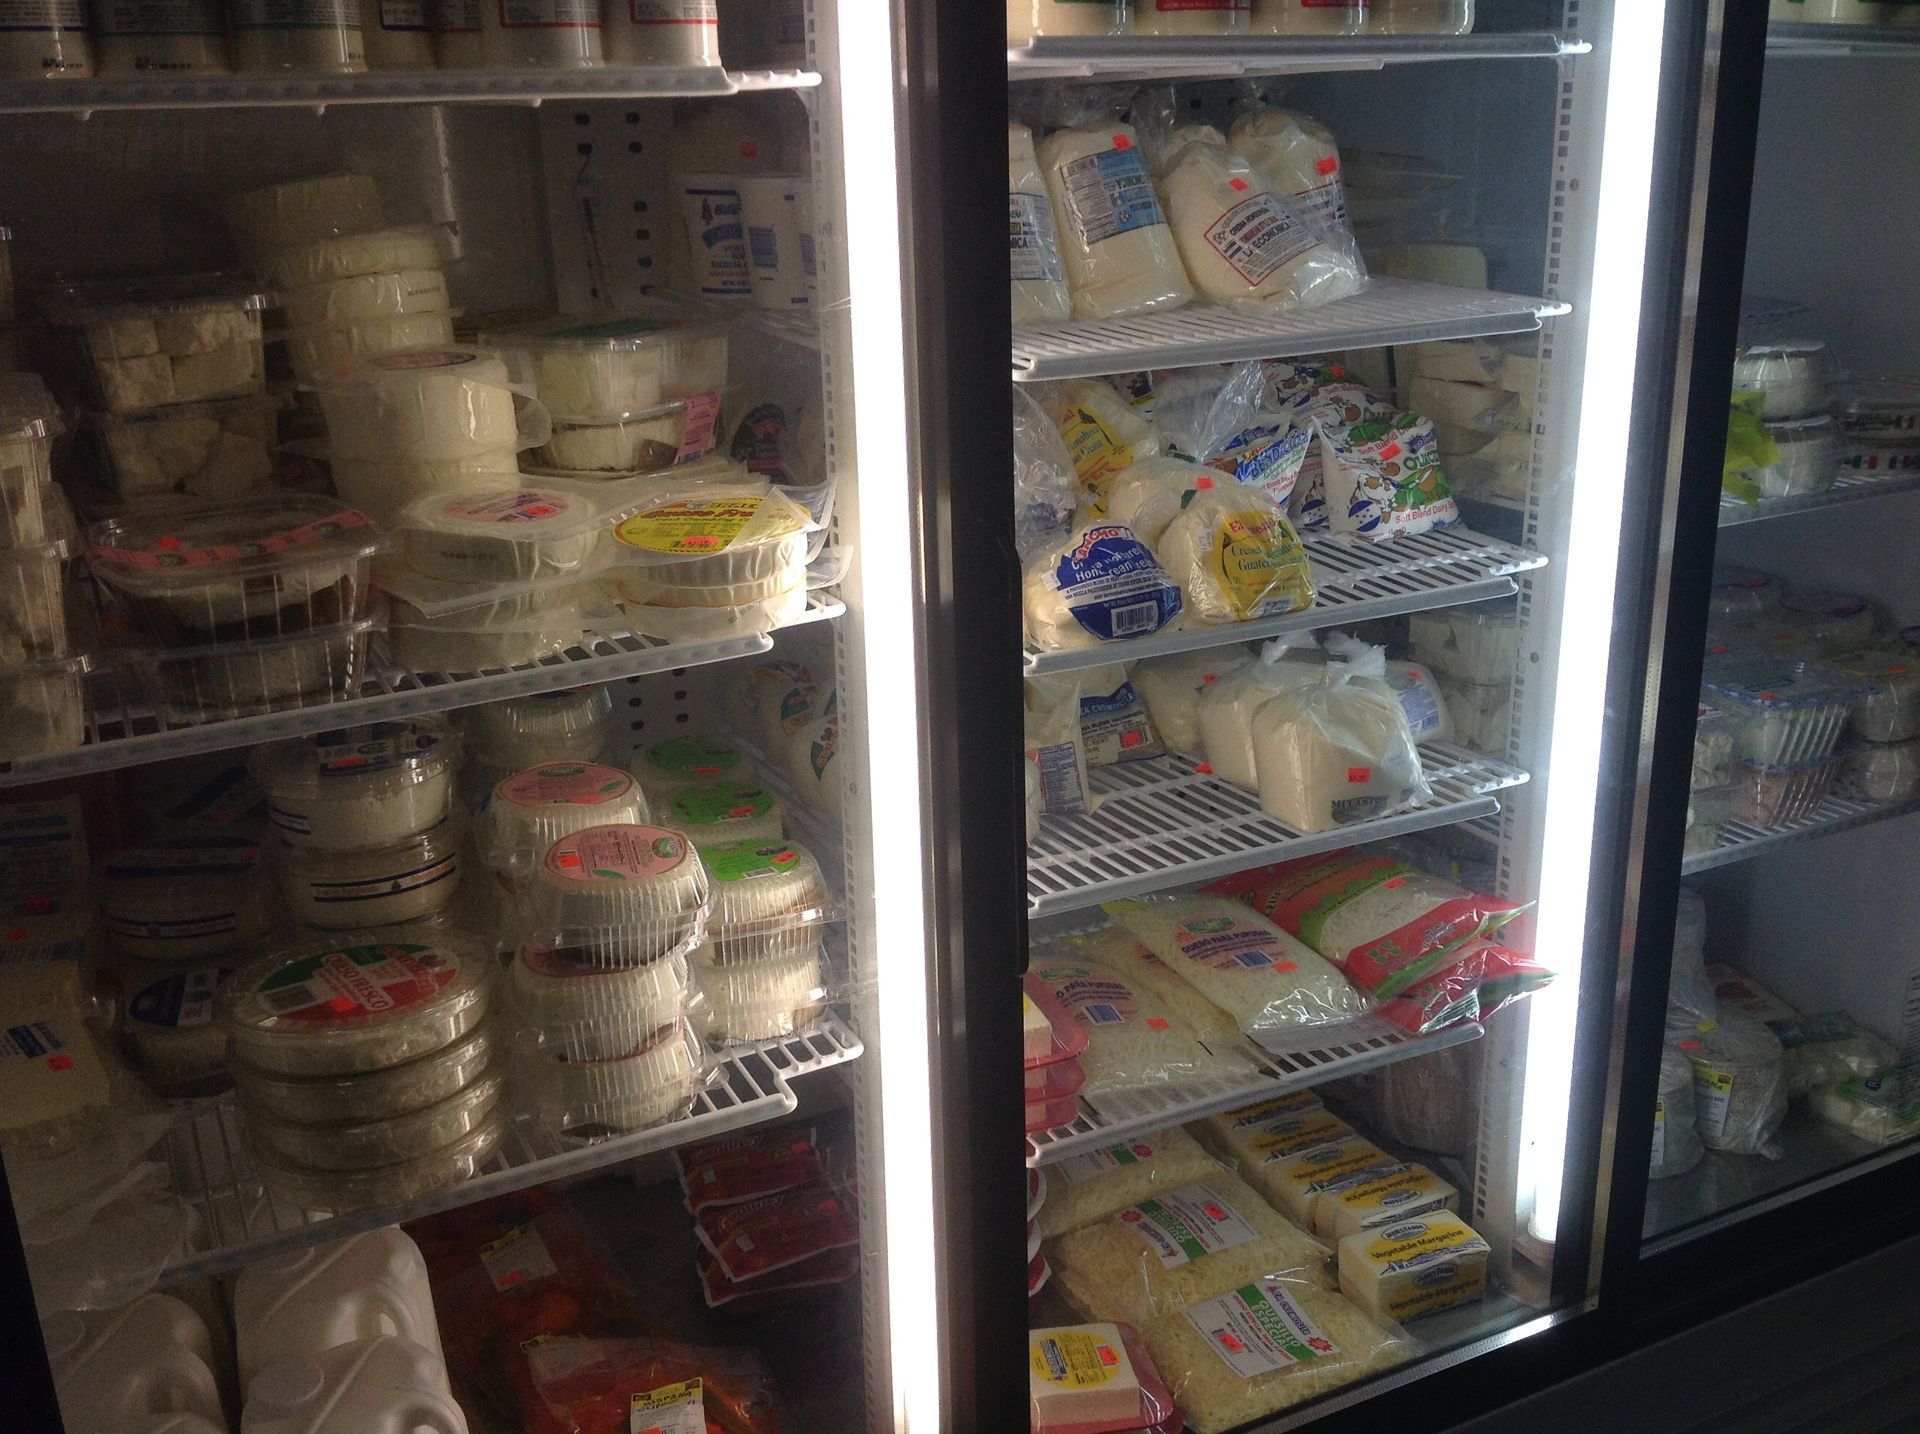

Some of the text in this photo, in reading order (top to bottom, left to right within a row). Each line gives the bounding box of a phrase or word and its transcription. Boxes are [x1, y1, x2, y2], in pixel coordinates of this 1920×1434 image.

[1375, 432, 1399, 450] Blend
[1395, 504, 1449, 524] Soft Blend Dairy
[1371, 1229, 1464, 1259] Vegetable Margarine
[1251, 1304, 1291, 1350] ESPECIAL
[1259, 1299, 1301, 1347] QUESILLO
